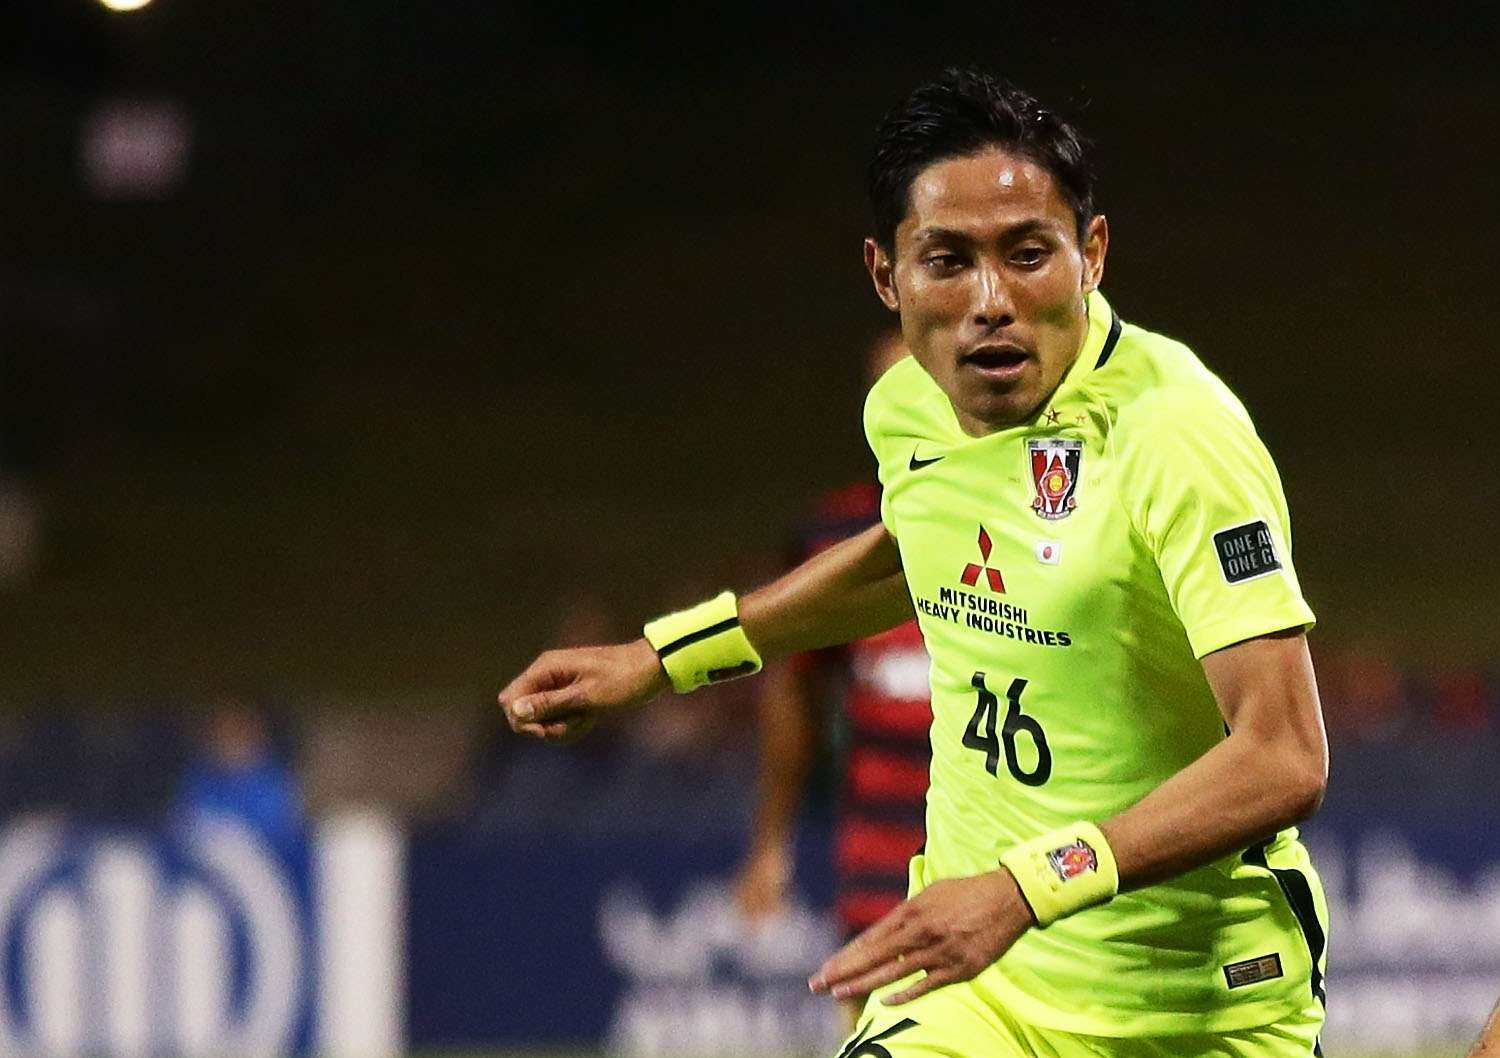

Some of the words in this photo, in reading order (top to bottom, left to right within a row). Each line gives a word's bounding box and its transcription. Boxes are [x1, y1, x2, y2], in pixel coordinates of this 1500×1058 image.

[1223, 534, 1254, 557] ONE
[1228, 552, 1259, 576] ONE
[916, 597, 960, 624] HEAVY
[966, 612, 1073, 647] INDUSTRIES
[940, 587, 1028, 625] MITSUBISHI
[962, 671, 1052, 787] 46
